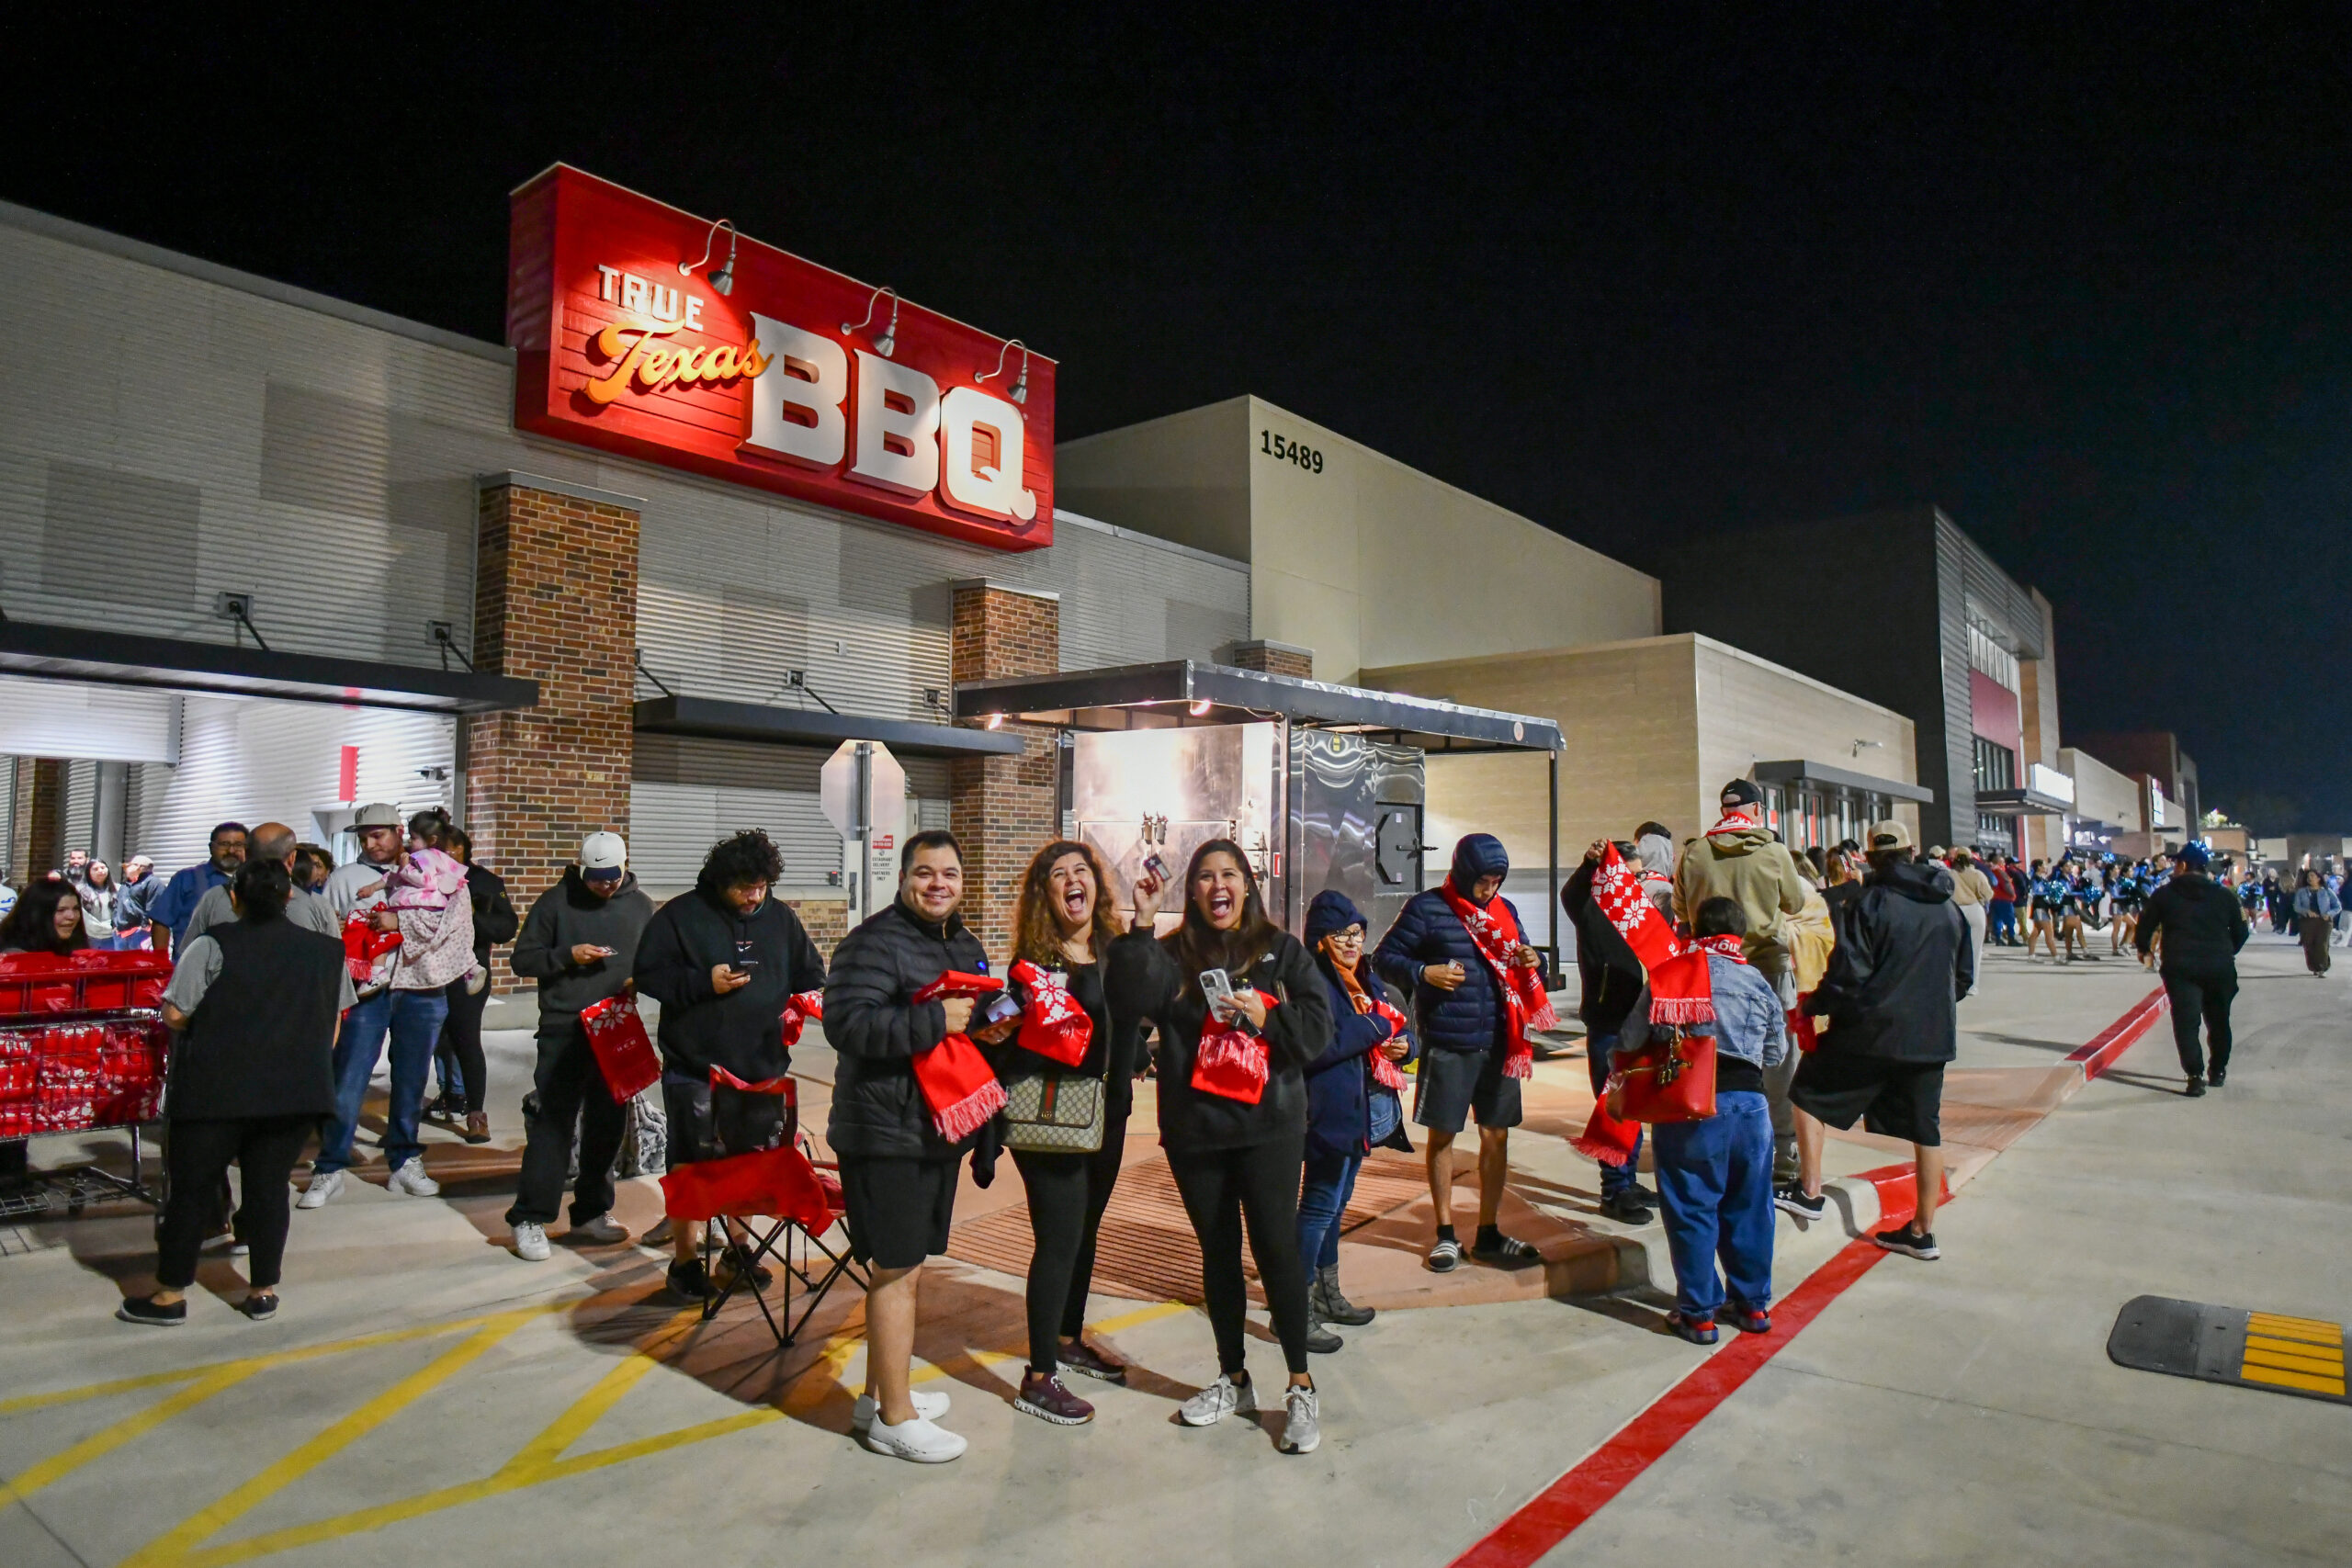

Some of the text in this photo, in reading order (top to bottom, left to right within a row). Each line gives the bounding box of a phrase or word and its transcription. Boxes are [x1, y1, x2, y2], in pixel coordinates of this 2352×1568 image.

[599, 265, 704, 331] TRUE
[586, 319, 775, 404] Texas
[745, 311, 1036, 520] BBQ
[1261, 429, 1323, 474] 15489
